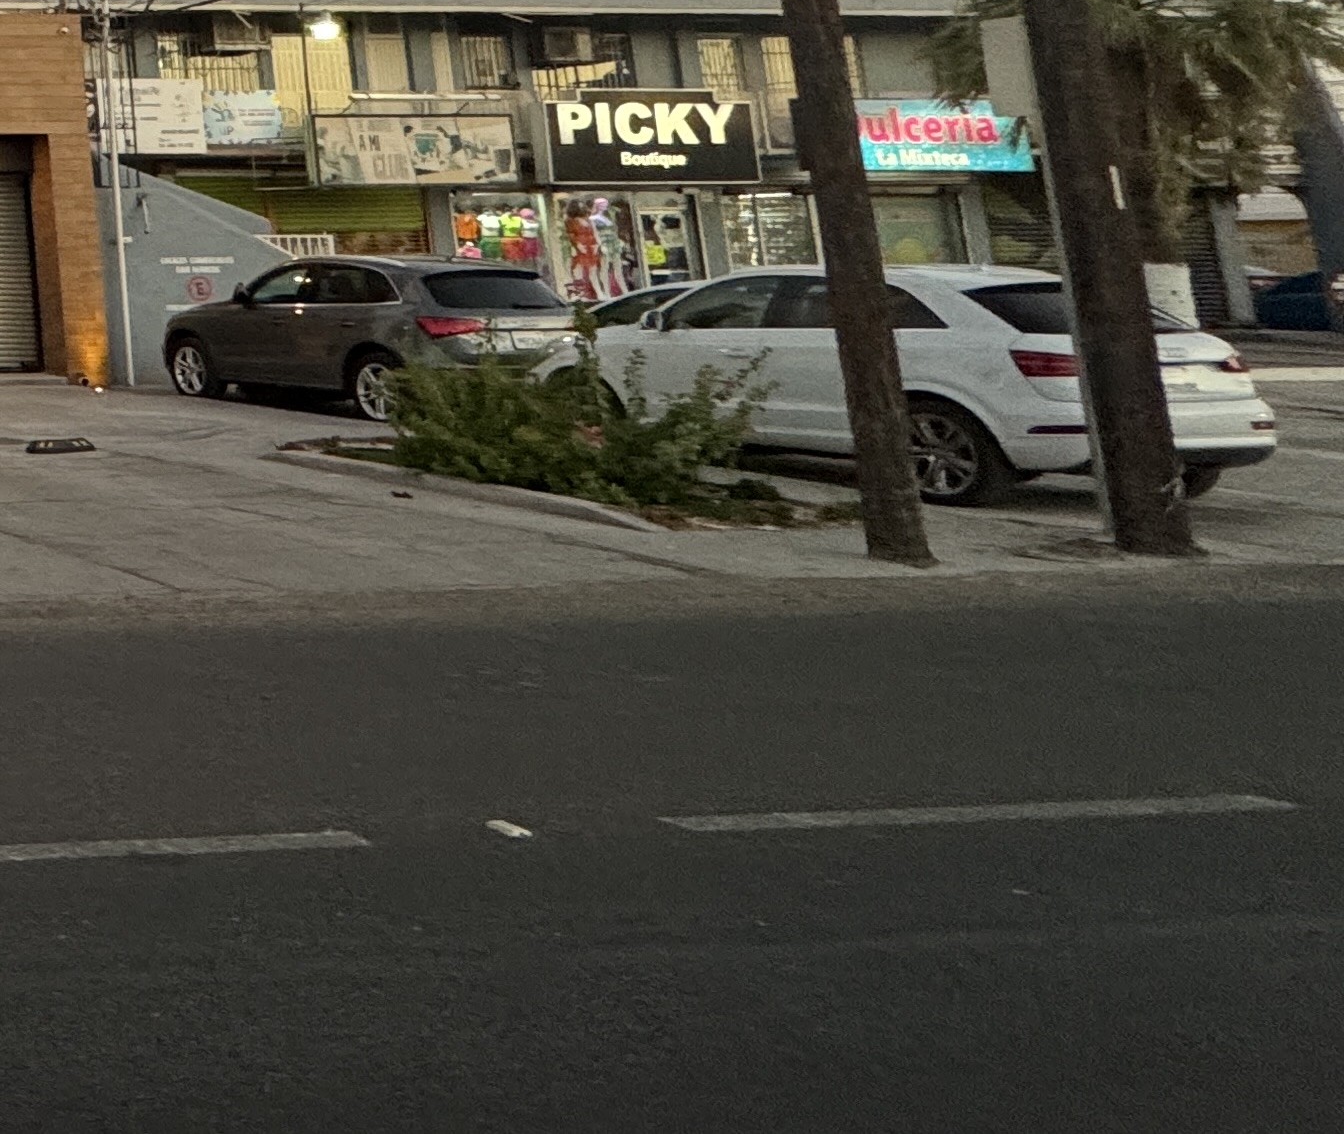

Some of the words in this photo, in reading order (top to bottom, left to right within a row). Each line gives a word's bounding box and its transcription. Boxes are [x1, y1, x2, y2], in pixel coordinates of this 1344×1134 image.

[556, 102, 734, 145] PICKY
[857, 106, 1000, 143] ulceria
[620, 151, 687, 169] Boutique
